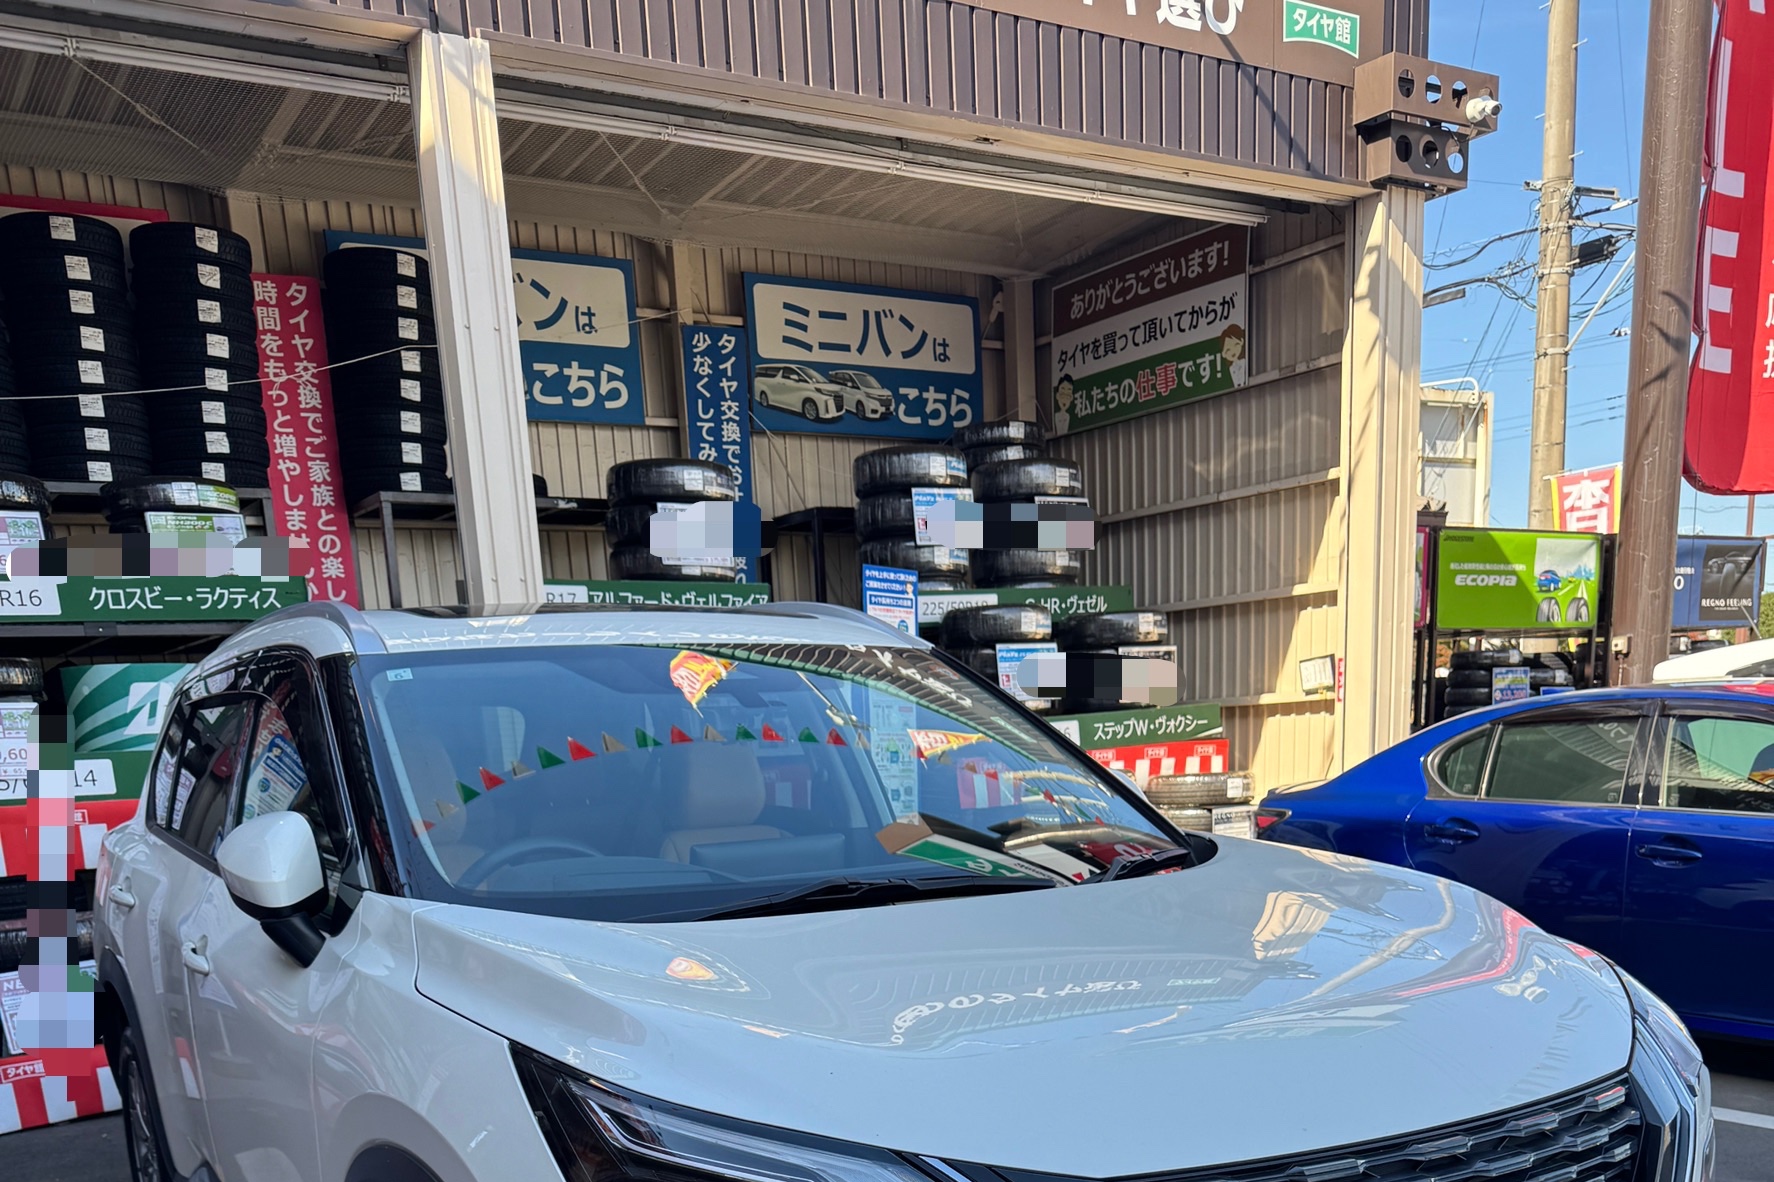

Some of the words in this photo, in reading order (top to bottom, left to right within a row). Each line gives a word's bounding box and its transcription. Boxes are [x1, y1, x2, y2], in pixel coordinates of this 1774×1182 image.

[1292, 7, 1352, 45] タイヤ館
[513, 276, 598, 335] ンは
[781, 300, 952, 363] ミニバンは
[1057, 291, 1239, 372] タイヤを買って頂いてからが
[532, 361, 629, 409] こちら
[897, 386, 973, 428] こちら
[1074, 352, 1222, 418] 私たちの仕事です!
[88, 586, 283, 611] クロスビー・ラクティス
[1094, 714, 1209, 741] ステップW・ヴォクシー
